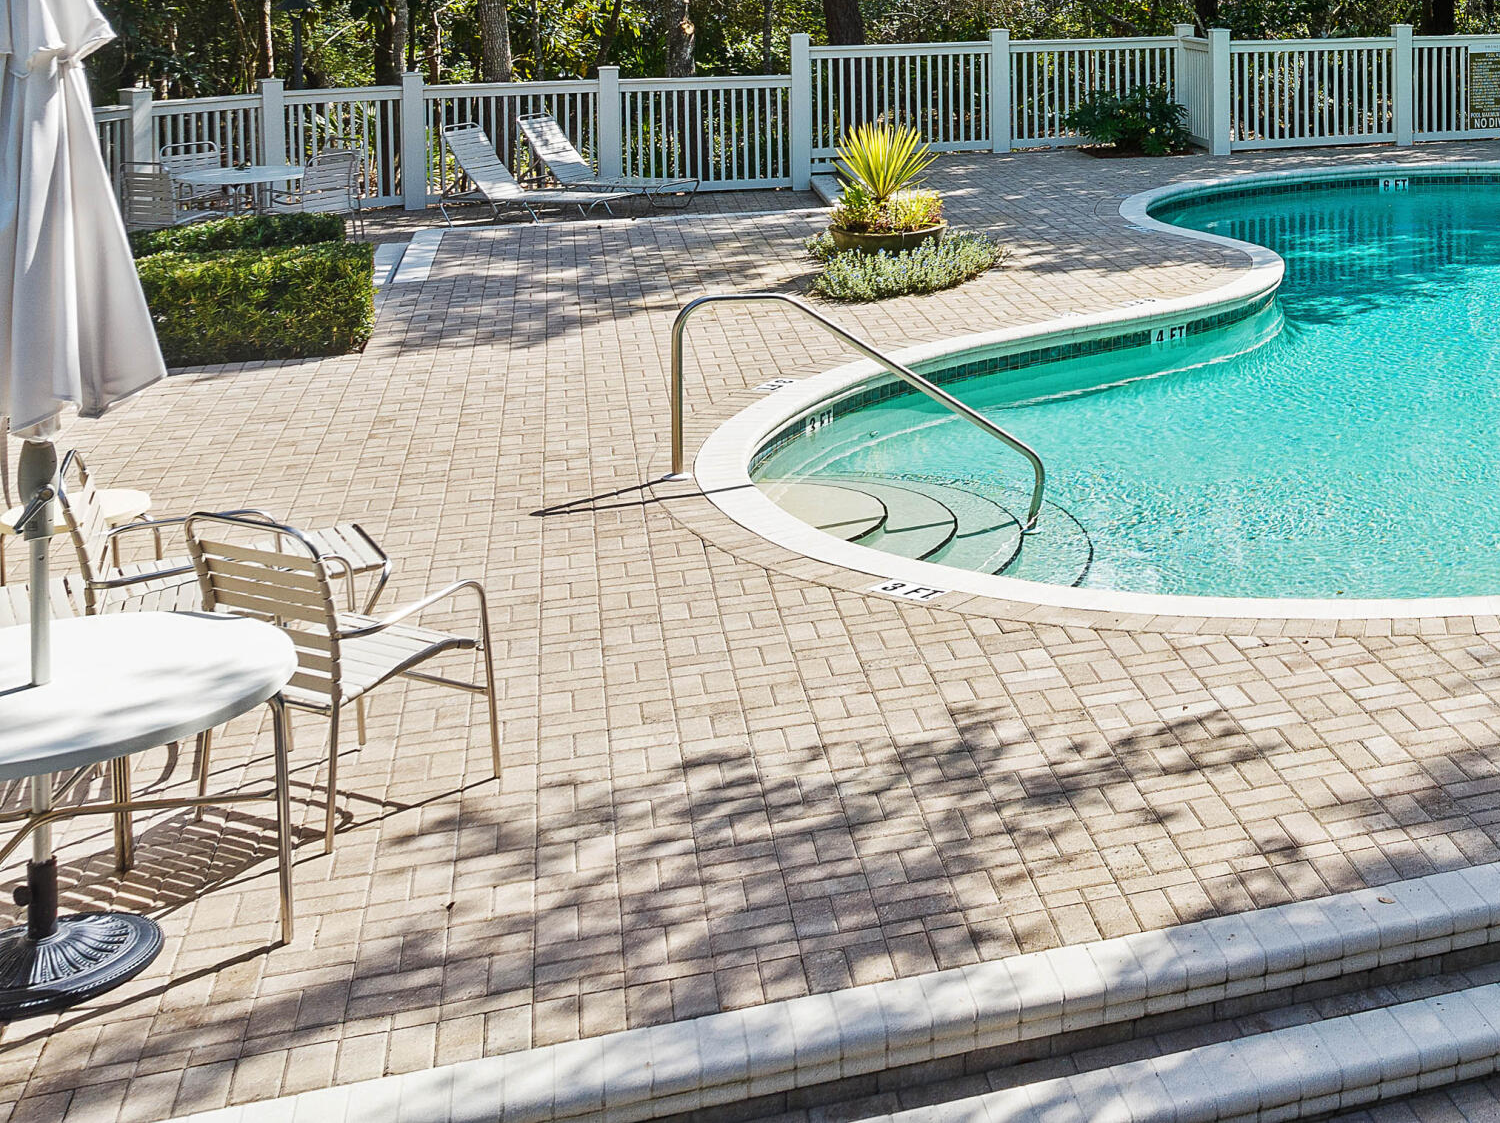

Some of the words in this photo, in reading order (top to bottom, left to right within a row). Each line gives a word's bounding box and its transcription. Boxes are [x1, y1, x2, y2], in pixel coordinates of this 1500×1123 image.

[1474, 118, 1487, 128] NO
[1394, 178, 1408, 189] FT
[1170, 325, 1185, 340] FT
[820, 408, 832, 427] FT
[881, 582, 907, 591] 3
[903, 587, 945, 599] FT
